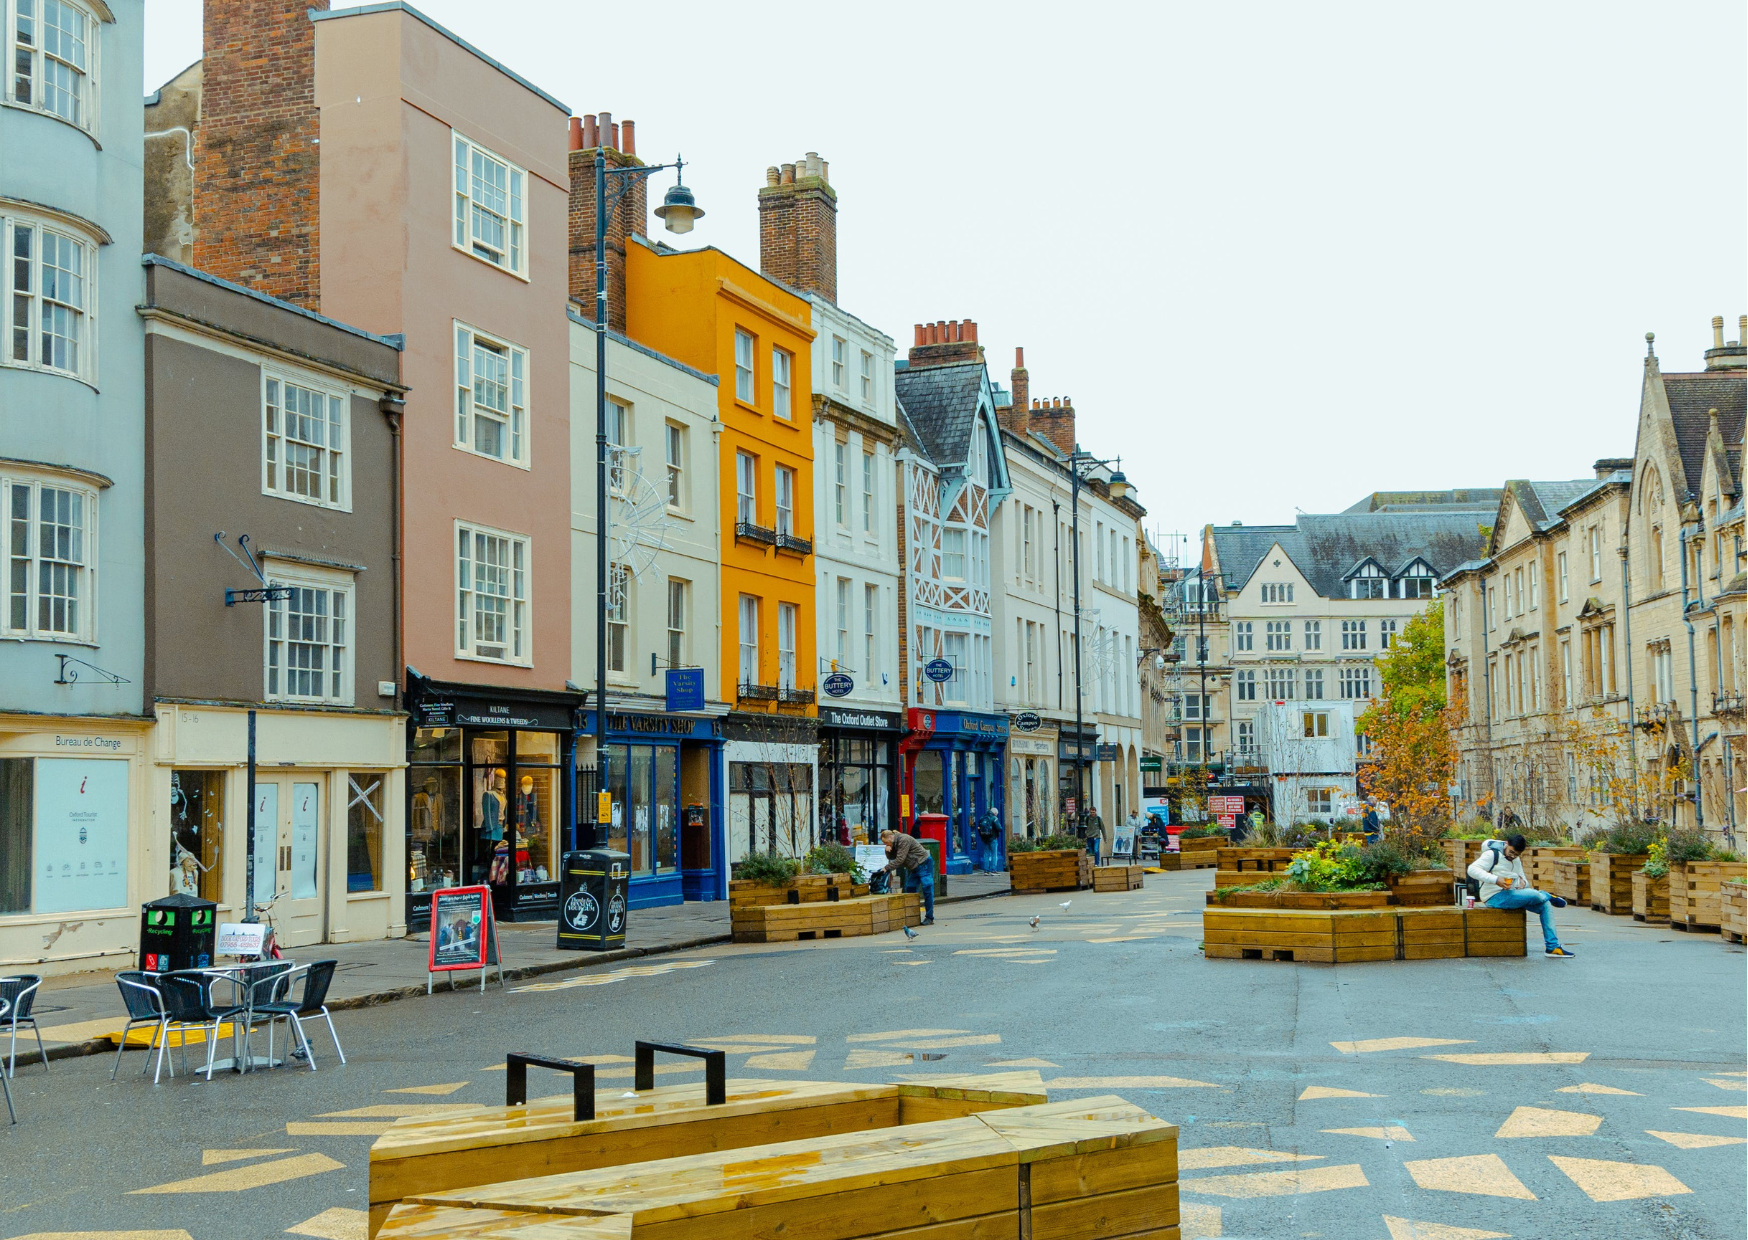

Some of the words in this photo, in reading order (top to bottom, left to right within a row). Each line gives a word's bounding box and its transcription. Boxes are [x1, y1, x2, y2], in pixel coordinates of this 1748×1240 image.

[824, 682, 852, 690] BUTTERY
[489, 705, 510, 714] KILTANE
[481, 716, 505, 724] WOOLLENS
[510, 717, 528, 725] TWEEDS
[577, 713, 587, 729] 13
[831, 712, 841, 724] The
[842, 713, 860, 725] Oxford
[860, 714, 875, 727] Outlet
[875, 716, 888, 728] Store
[1017, 712, 1039, 721] Oxford
[607, 714, 628, 730] THE
[630, 715, 670, 733] VARSITY
[671, 718, 695, 734] SHOP
[711, 721, 721, 735] 13
[963, 718, 978, 731] Oxford
[56, 735, 82, 746] Bureau
[83, 737, 93, 747] de
[94, 736, 121, 750] Change
[148, 927, 173, 936] Recycling
